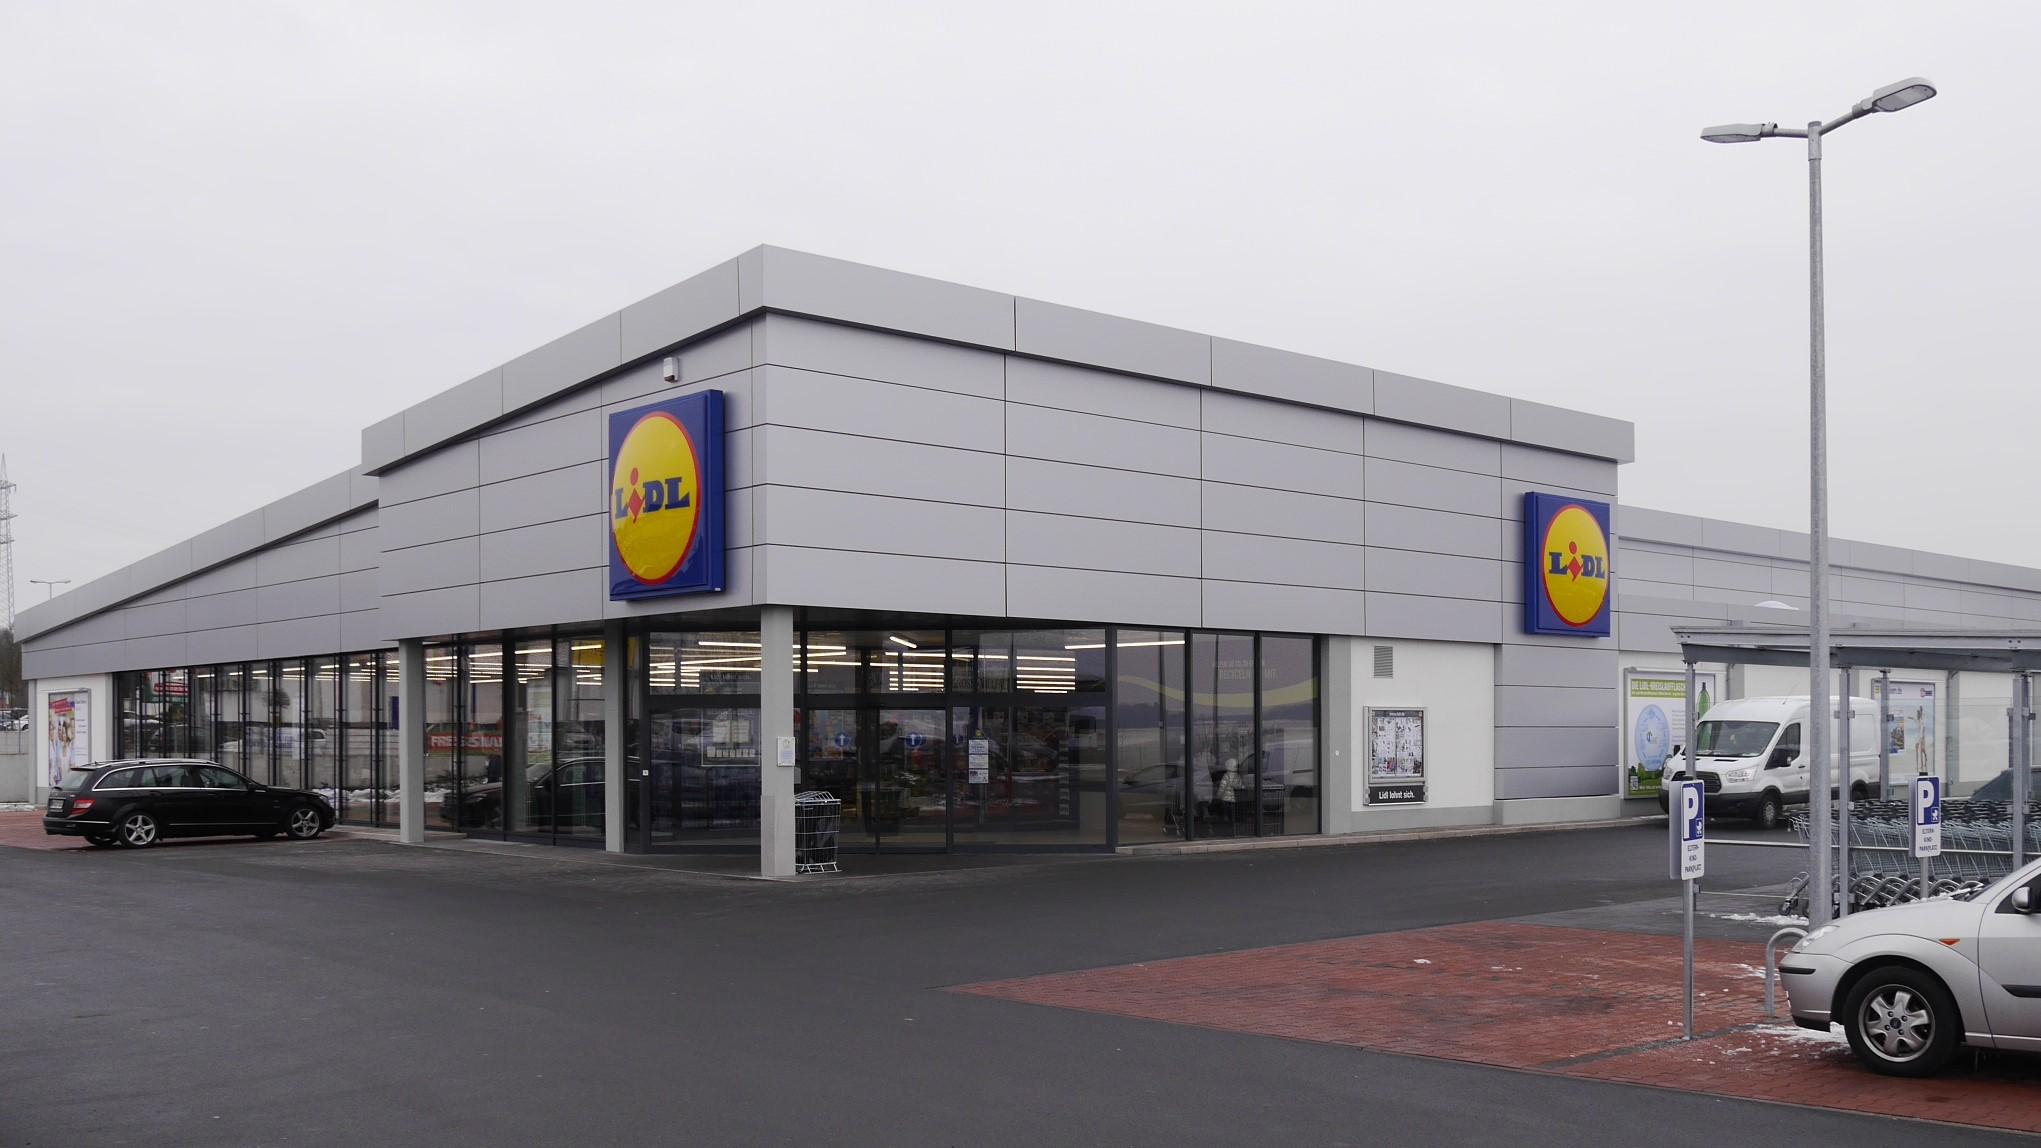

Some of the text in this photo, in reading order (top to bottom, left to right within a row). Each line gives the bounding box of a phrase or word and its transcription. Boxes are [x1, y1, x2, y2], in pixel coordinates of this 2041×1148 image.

[1379, 791, 1388, 799] Lidl
[1390, 790, 1403, 799] lohnt
[1683, 786, 1699, 839] P
[1917, 780, 1934, 824] P
